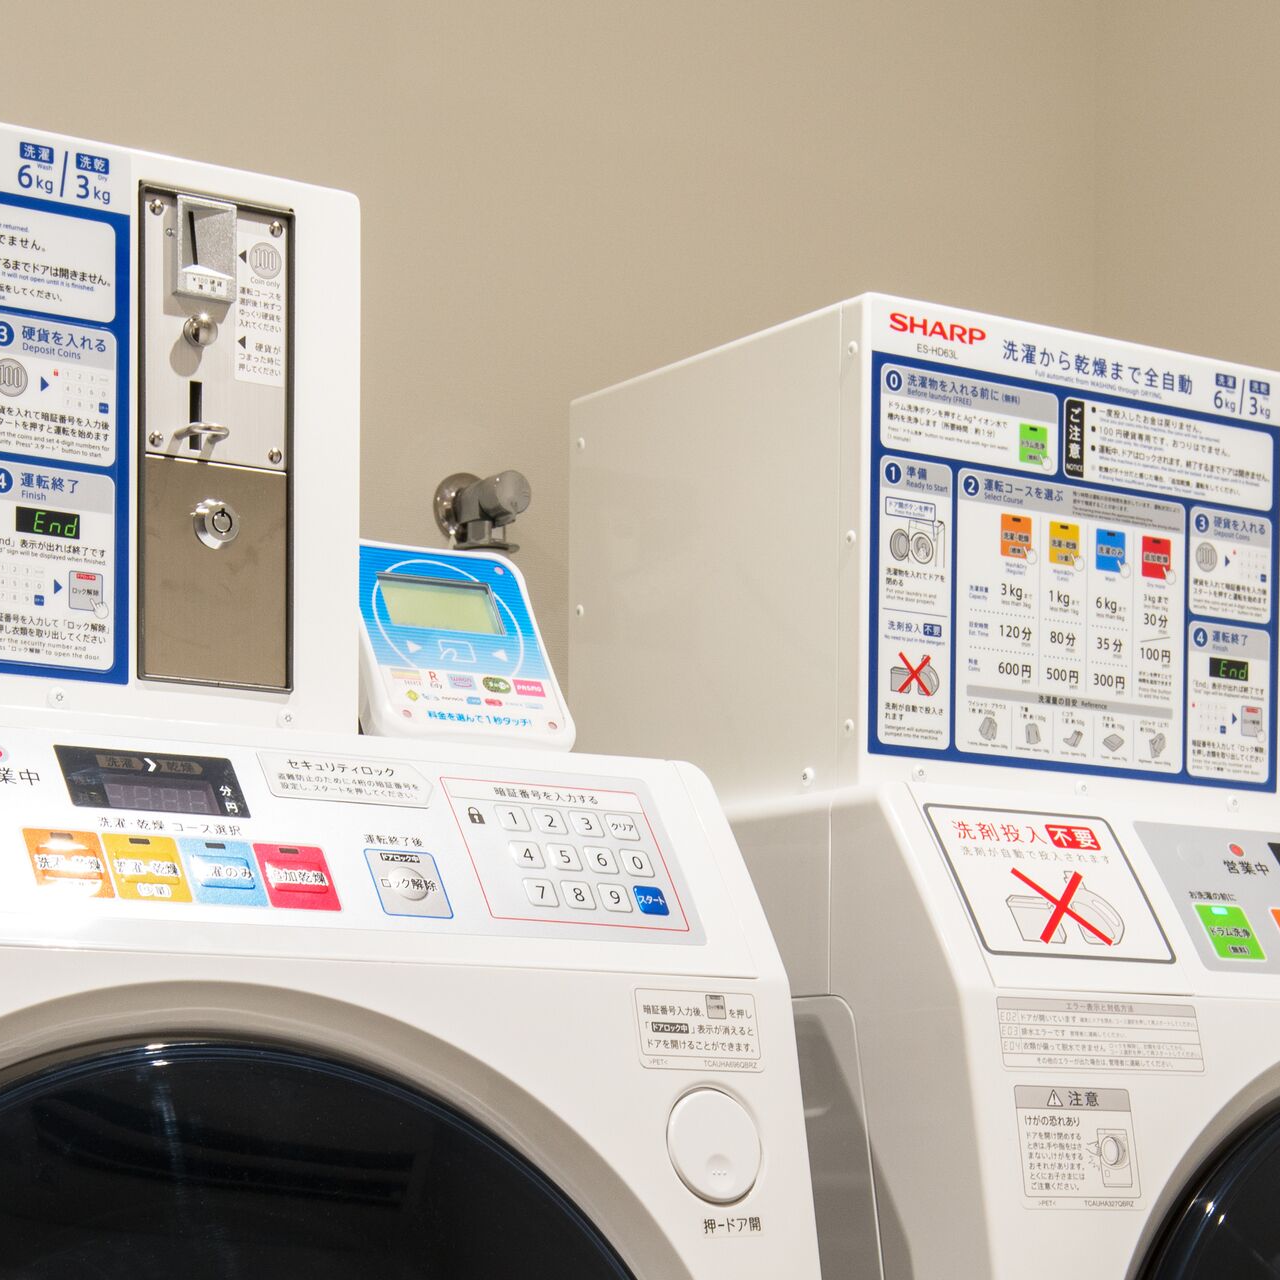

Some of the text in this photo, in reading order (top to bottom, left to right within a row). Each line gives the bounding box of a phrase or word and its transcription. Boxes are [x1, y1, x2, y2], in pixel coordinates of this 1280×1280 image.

[23, 144, 51, 162] 洗濯
[889, 312, 986, 345] SHARP
[21, 325, 107, 353] 硬貨を入れる
[22, 342, 81, 360] Deposit Coins
[1002, 339, 1193, 395] 洗濯から乾燥まで全自動
[20, 471, 80, 494] 運転終了
[21, 490, 47, 501] Finish
[33, 511, 79, 537] End
[1220, 660, 1248, 680] End
[508, 812, 518, 825] 1
[544, 814, 557, 828] 2
[581, 817, 593, 831] 3
[611, 822, 634, 832] クリア
[951, 820, 1097, 849] 洗剤投入 不要
[523, 848, 535, 861] 4
[559, 850, 571, 864] 5
[596, 853, 608, 867] 6
[632, 856, 644, 870] 0
[1223, 860, 1269, 876] 営業中
[535, 885, 545, 899] 7
[573, 887, 585, 902] 8
[609, 890, 621, 905] 9
[637, 894, 666, 906] スタート
[1068, 1090, 1100, 1107] 注意
